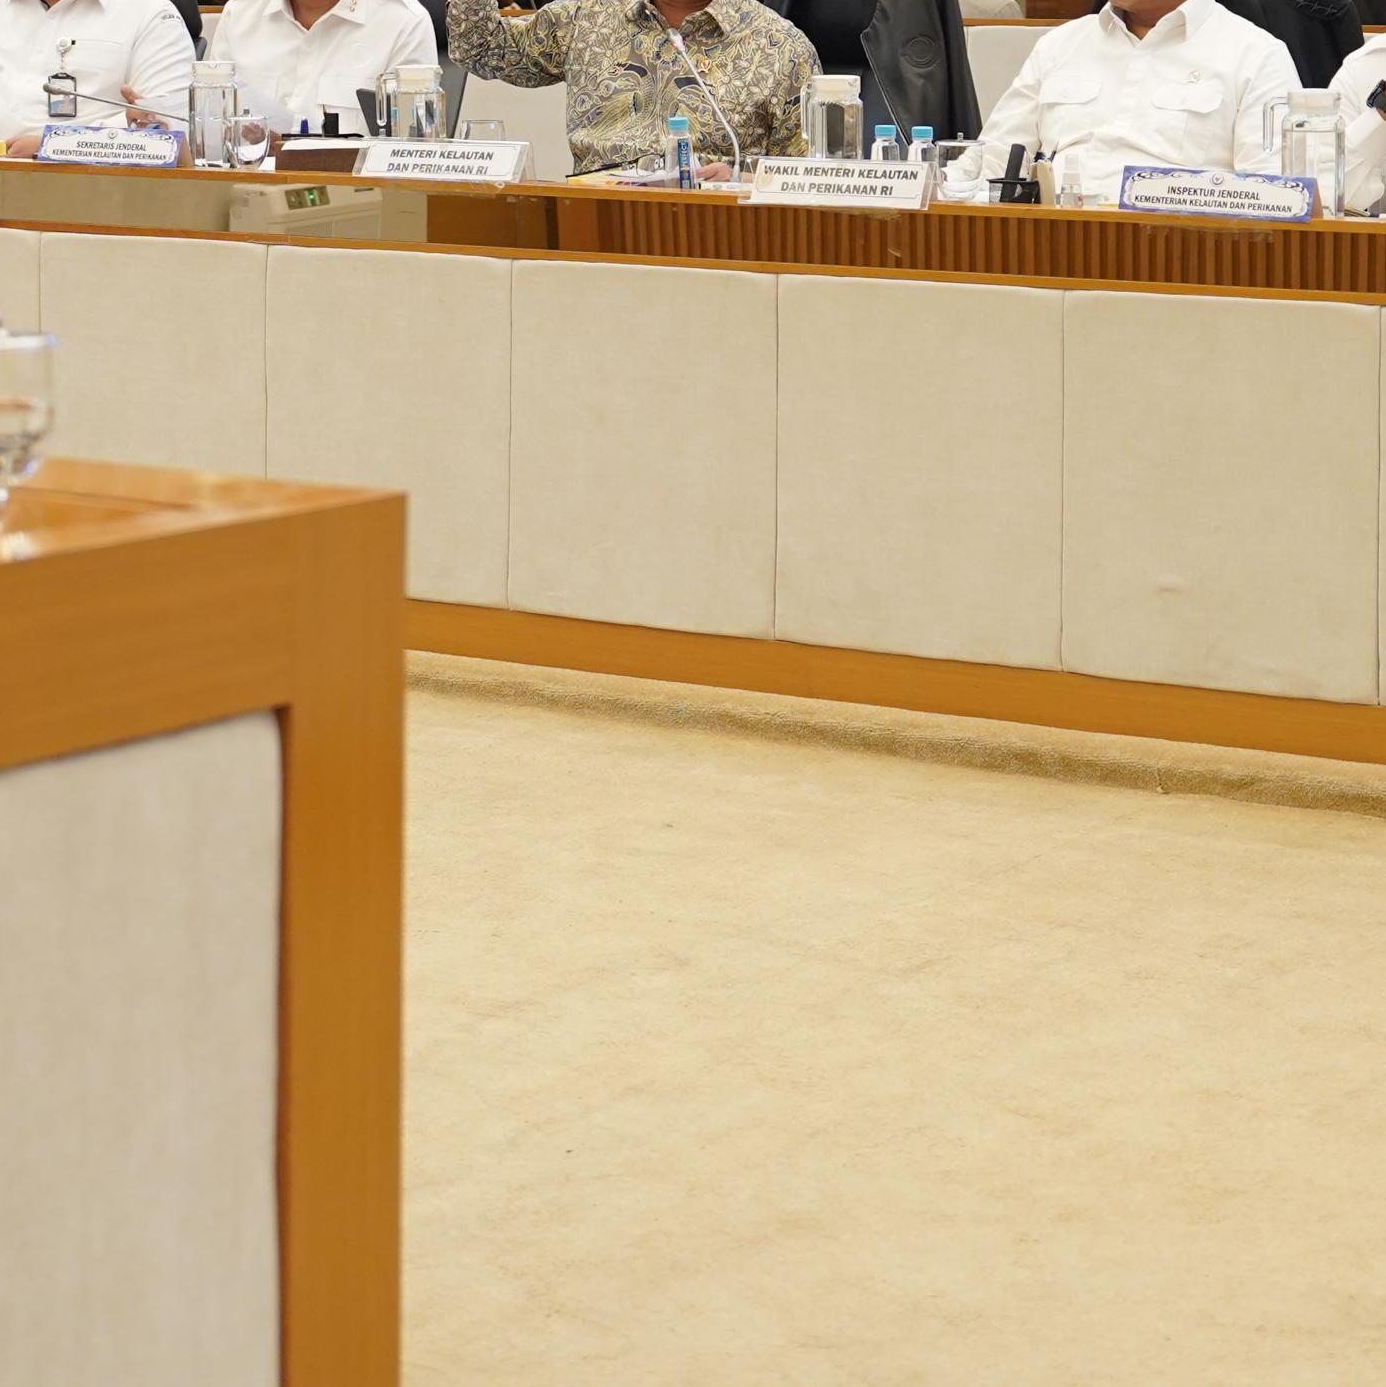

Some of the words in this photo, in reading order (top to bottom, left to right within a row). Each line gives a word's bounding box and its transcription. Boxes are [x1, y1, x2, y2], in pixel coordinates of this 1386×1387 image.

[76, 141, 114, 150] SEKRETARIS
[116, 143, 146, 152] JENDERAL
[52, 148, 92, 158] KEMENTERIAN
[94, 151, 121, 159] KELAUTAN
[122, 152, 134, 160] DAN
[135, 153, 166, 161] PERIKANAN
[390, 149, 437, 159] MENTERI
[439, 150, 494, 161] KELAUTAN
[387, 163, 409, 173] DAN
[413, 163, 474, 175] PERIKANAN
[476, 165, 489, 175] RI
[764, 165, 800, 176] WAKIL
[803, 166, 855, 178] MENTERI
[858, 169, 918, 181] KELAUTAN
[781, 181, 806, 192] DAN
[808, 183, 878, 195] PERIKANAN
[880, 185, 893, 196] RI
[1167, 185, 1215, 198] INSPEKTUR
[1217, 189, 1260, 200] JENDERAL
[1134, 195, 1187, 206] KEMENTERIAN
[1189, 198, 1228, 208] KELAUTAN
[1230, 201, 1245, 210] DAN
[1247, 202, 1293, 213] PERIKANAN
